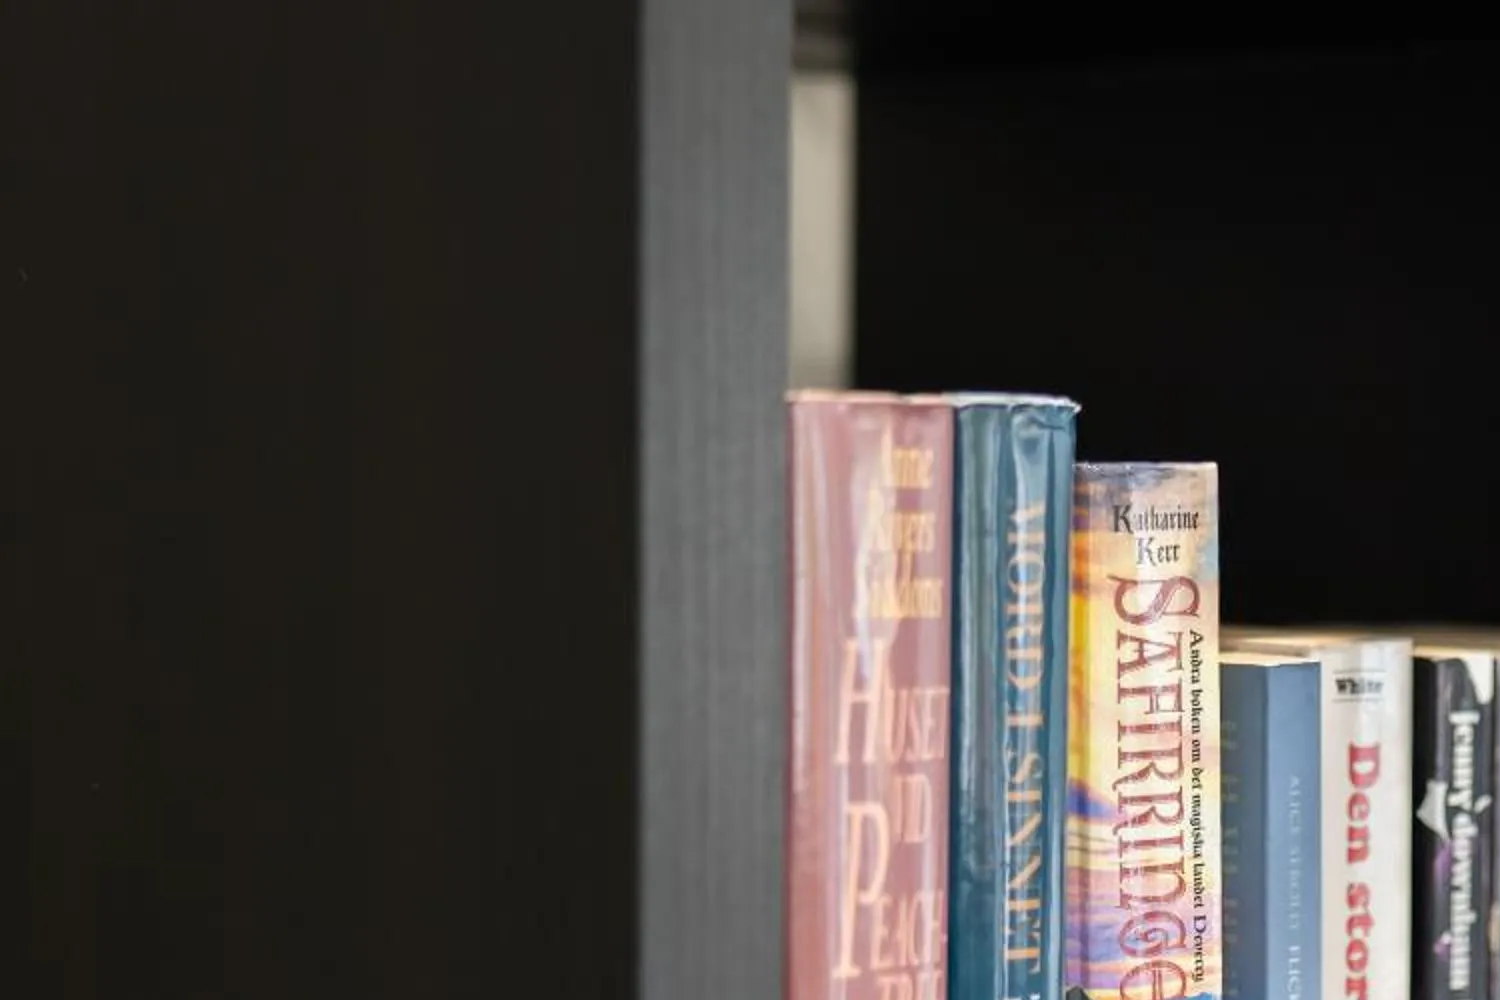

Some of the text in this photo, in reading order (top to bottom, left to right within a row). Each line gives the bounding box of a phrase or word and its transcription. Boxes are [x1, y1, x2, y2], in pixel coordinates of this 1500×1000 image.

[1112, 504, 1199, 534] Katharine
[1135, 536, 1181, 567] Kerr
[1189, 629, 1203, 684] Andra
[1190, 688, 1203, 735] boken
[1003, 504, 1045, 975] MORD I SINNET
[1191, 739, 1200, 762] om
[1344, 742, 1382, 864] Den
